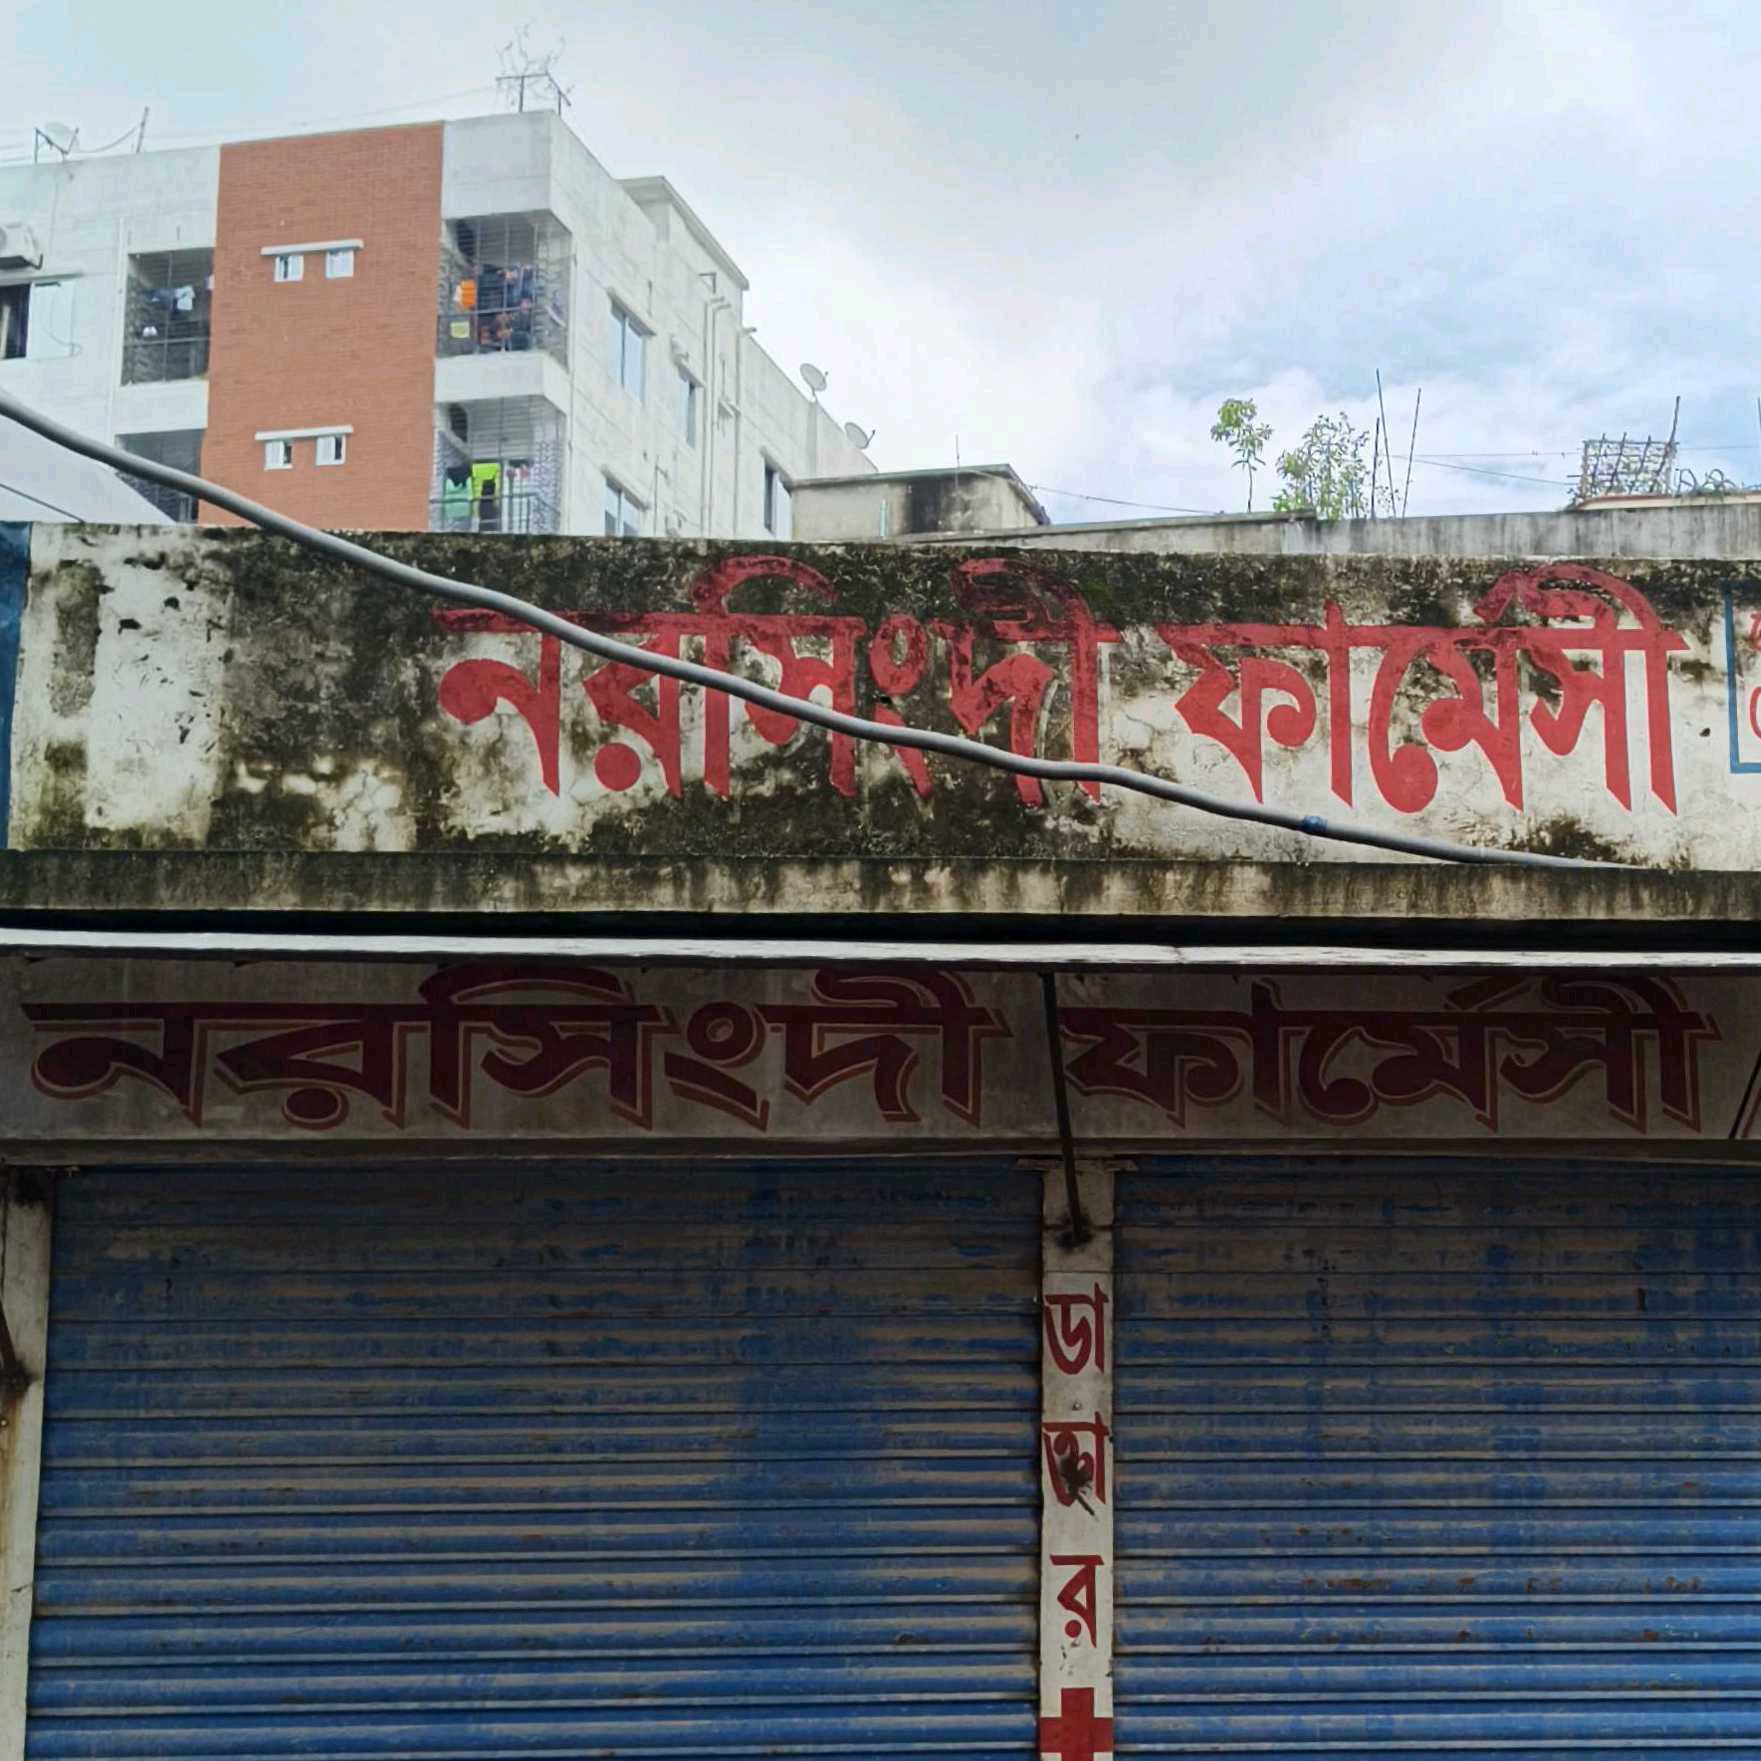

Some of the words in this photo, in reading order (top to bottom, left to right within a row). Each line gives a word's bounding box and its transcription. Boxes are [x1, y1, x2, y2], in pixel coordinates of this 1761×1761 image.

[432, 555, 1121, 807] নরসিংদী
[1156, 562, 1691, 817] ফার্মেসী
[21, 961, 1012, 1130] নরসিংদী
